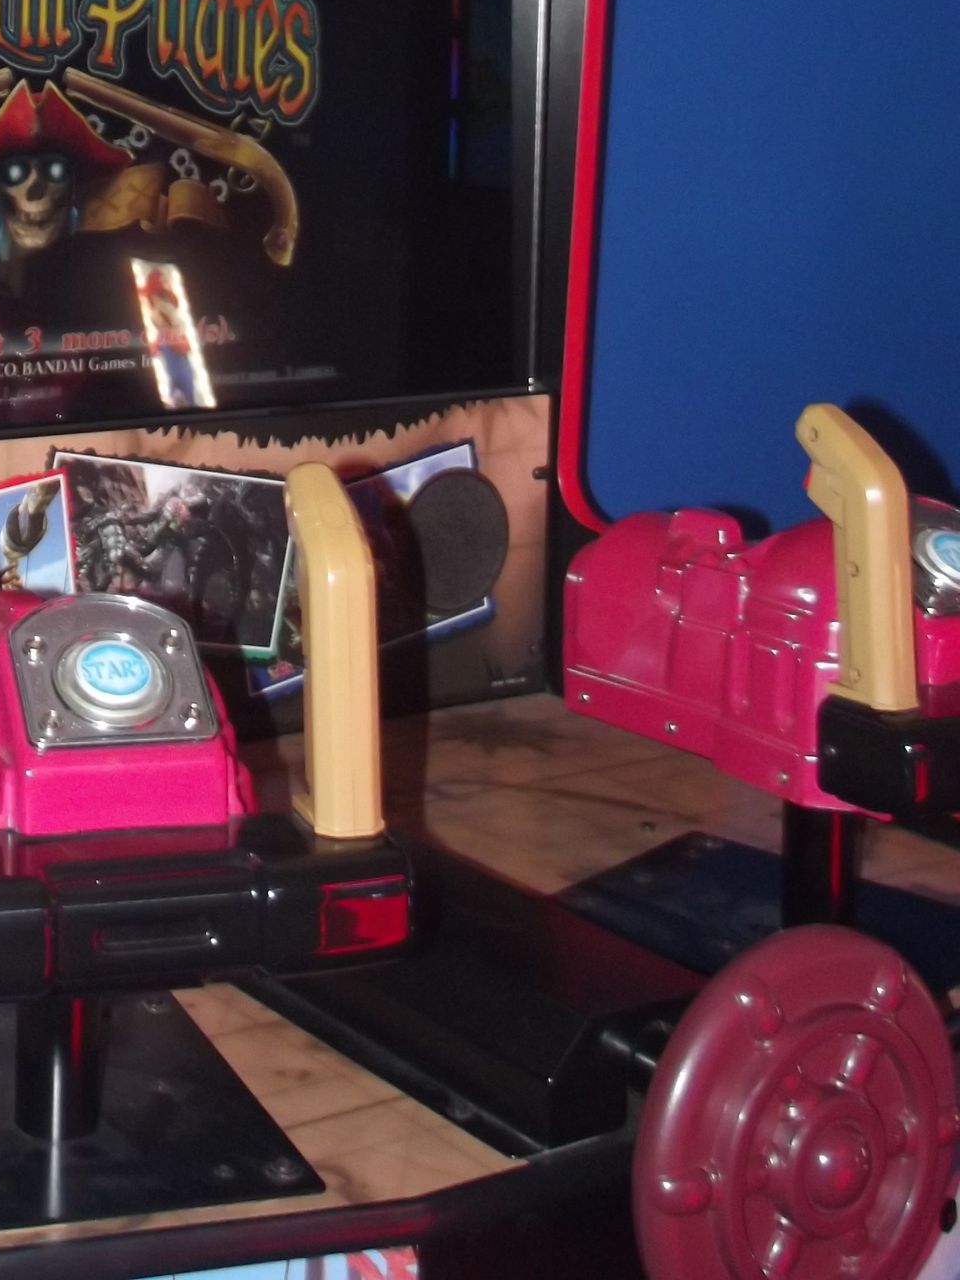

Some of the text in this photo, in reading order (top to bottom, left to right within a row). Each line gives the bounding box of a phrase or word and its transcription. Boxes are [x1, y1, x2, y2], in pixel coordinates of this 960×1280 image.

[23, 326, 43, 354] 3
[60, 329, 132, 352] more
[22, 357, 84, 376] BANDAI
[89, 357, 136, 371] Games
[82, 658, 145, 680] START
